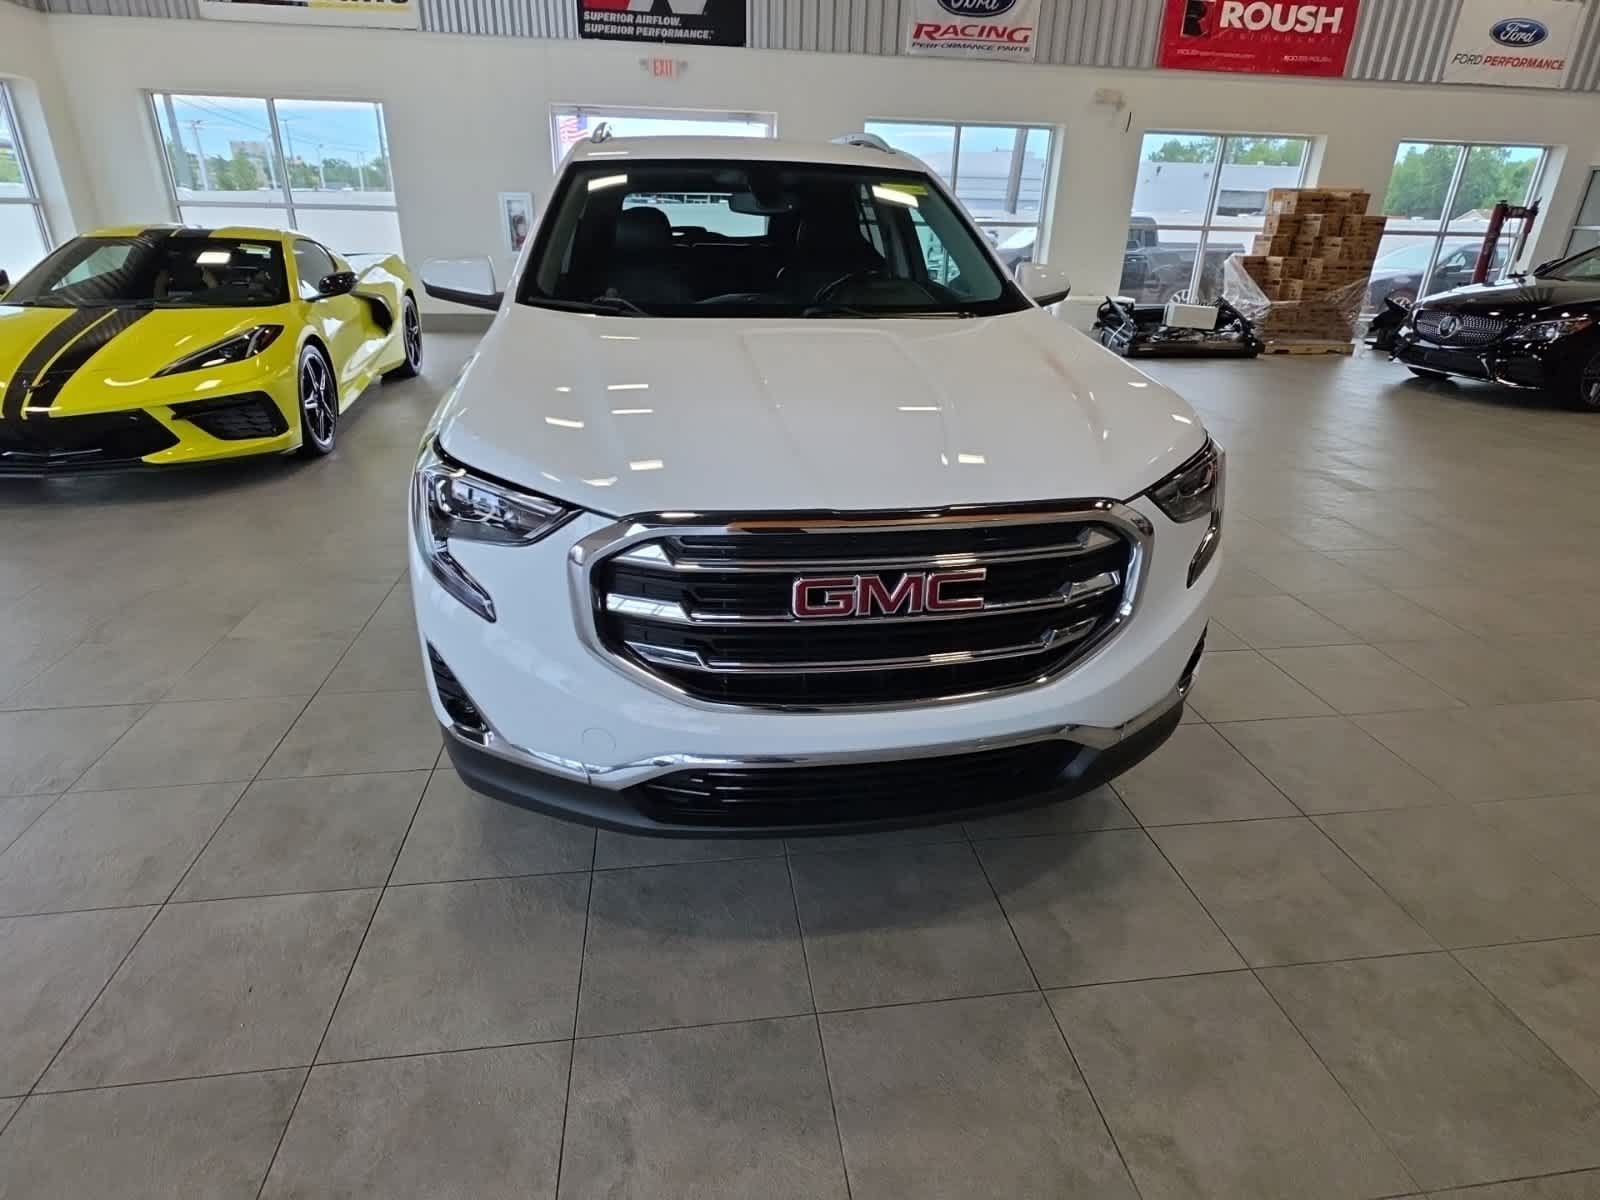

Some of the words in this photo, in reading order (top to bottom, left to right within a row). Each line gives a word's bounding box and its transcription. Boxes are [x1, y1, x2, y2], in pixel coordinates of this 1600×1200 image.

[583, 11, 634, 23] SUPERIOR
[635, 15, 682, 26] AIRFLOW.
[1219, 2, 1343, 33] ROUSH
[584, 23, 635, 35] SUPERIOR
[636, 27, 712, 40] PERFORMANCE.
[912, 23, 1032, 43] RACING
[1500, 22, 1537, 42] Ford
[912, 42, 994, 50] PERFORMANCE
[653, 59, 673, 76] EXIT
[1452, 53, 1482, 65] FORD
[1483, 55, 1566, 70] PERFORMANCE
[792, 568, 987, 618] GMC
